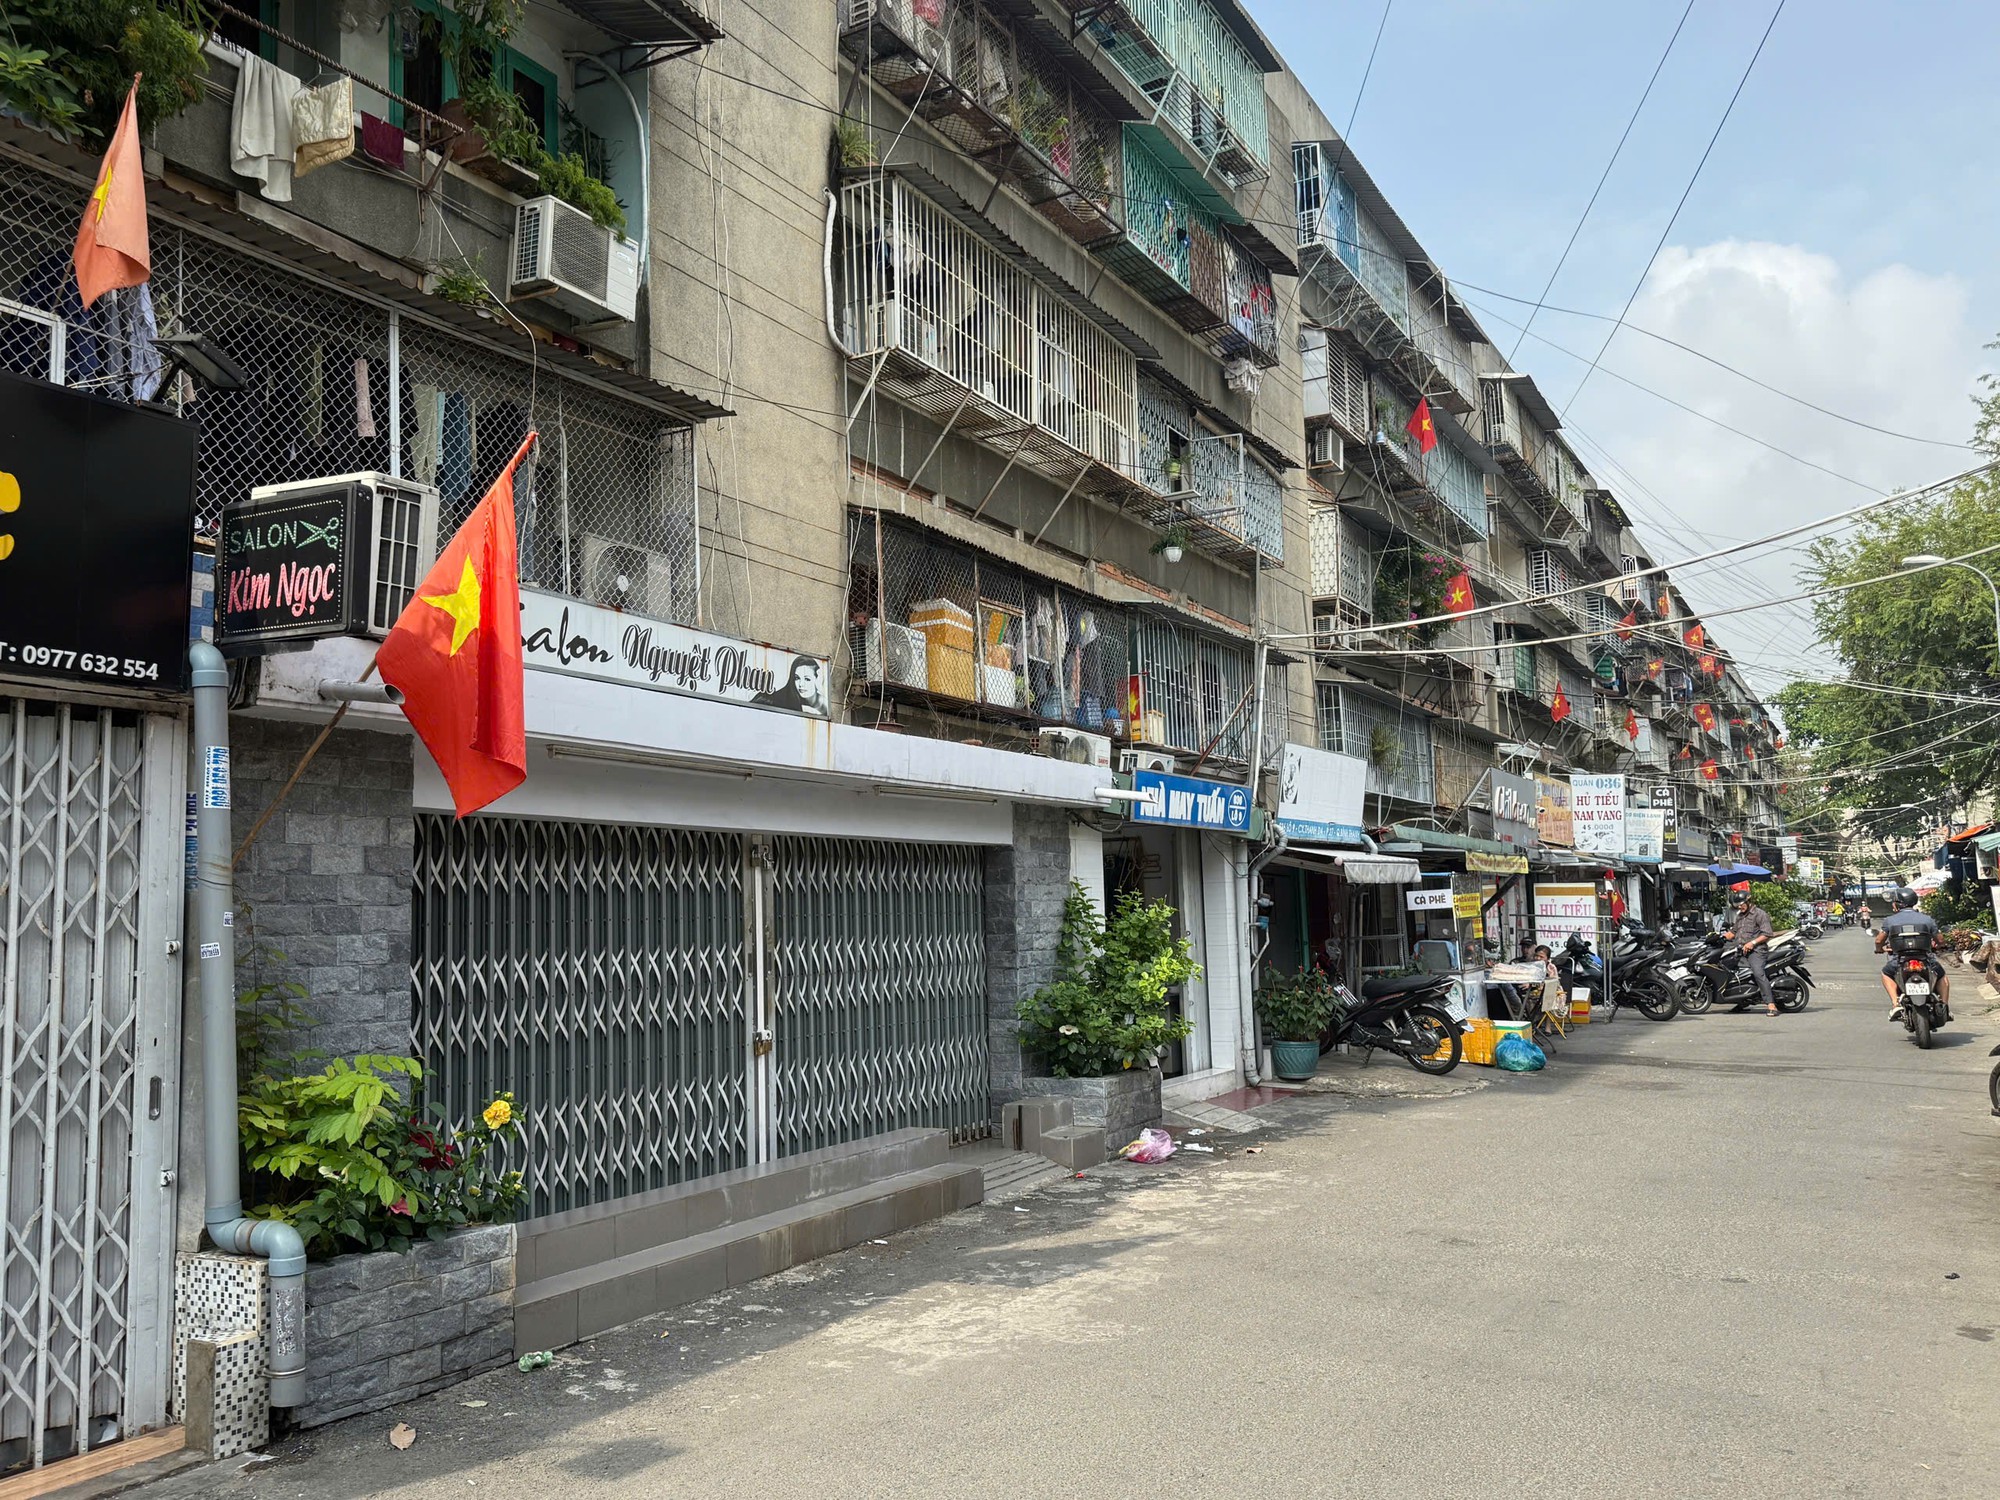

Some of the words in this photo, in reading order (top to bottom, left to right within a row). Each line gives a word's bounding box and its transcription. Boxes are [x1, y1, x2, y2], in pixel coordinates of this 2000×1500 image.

[230, 521, 297, 554] SALON
[227, 566, 271, 614] Kim
[276, 561, 336, 617] Ngọc
[519, 602, 614, 665] alon
[621, 623, 711, 691] Nguyệt
[715, 645, 775, 694] Phan
[22, 645, 77, 669] 0977
[80, 653, 118, 675] 632
[123, 658, 159, 681] 554
[1596, 778, 1621, 789] 036
[1140, 780, 1166, 818] NHÀ
[1168, 790, 1195, 820] MAY
[1197, 787, 1225, 824] TUẤN
[1576, 792, 1590, 806] HỦ
[1594, 791, 1619, 806] TIẾU
[1653, 797, 1673, 807] PHÊ
[1574, 811, 1594, 820] NAM
[1597, 811, 1622, 821] VANG
[1414, 894, 1426, 905] CÀ
[1429, 893, 1446, 904] PHÊ
[1539, 925, 1562, 938] NAM
